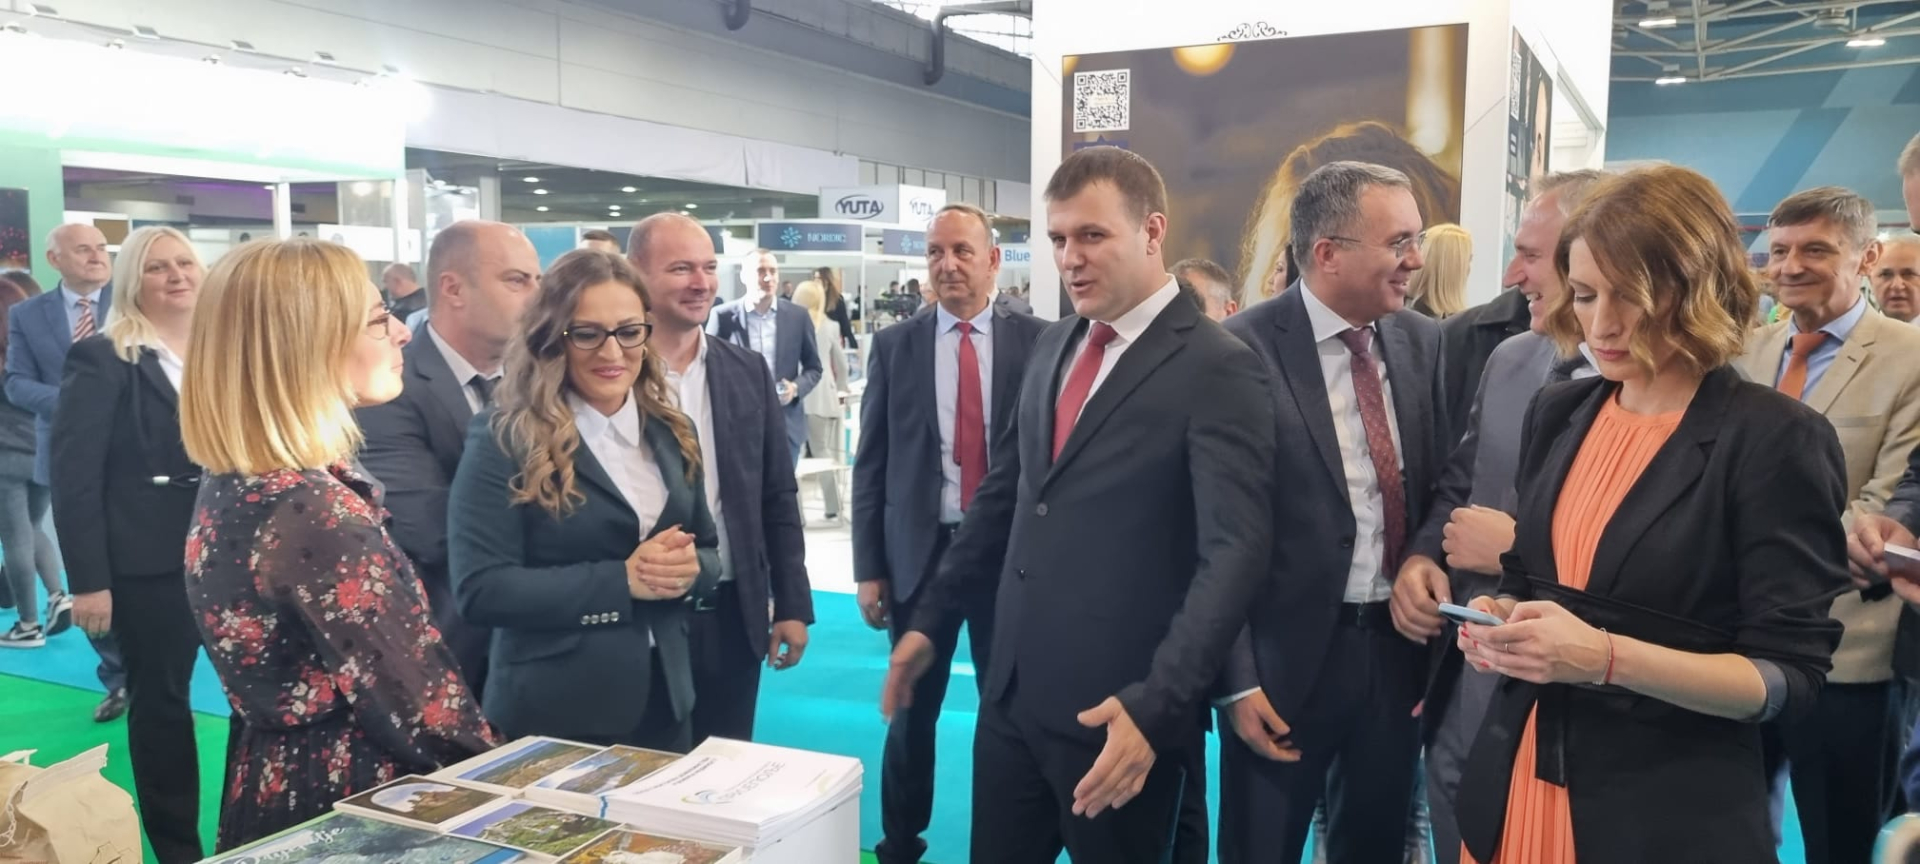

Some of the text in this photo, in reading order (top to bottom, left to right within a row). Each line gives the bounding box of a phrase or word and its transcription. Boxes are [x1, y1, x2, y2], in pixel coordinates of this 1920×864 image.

[840, 200, 881, 214] YUTA
[807, 232, 847, 243] NORDIC
[1004, 249, 1031, 262] Blue
